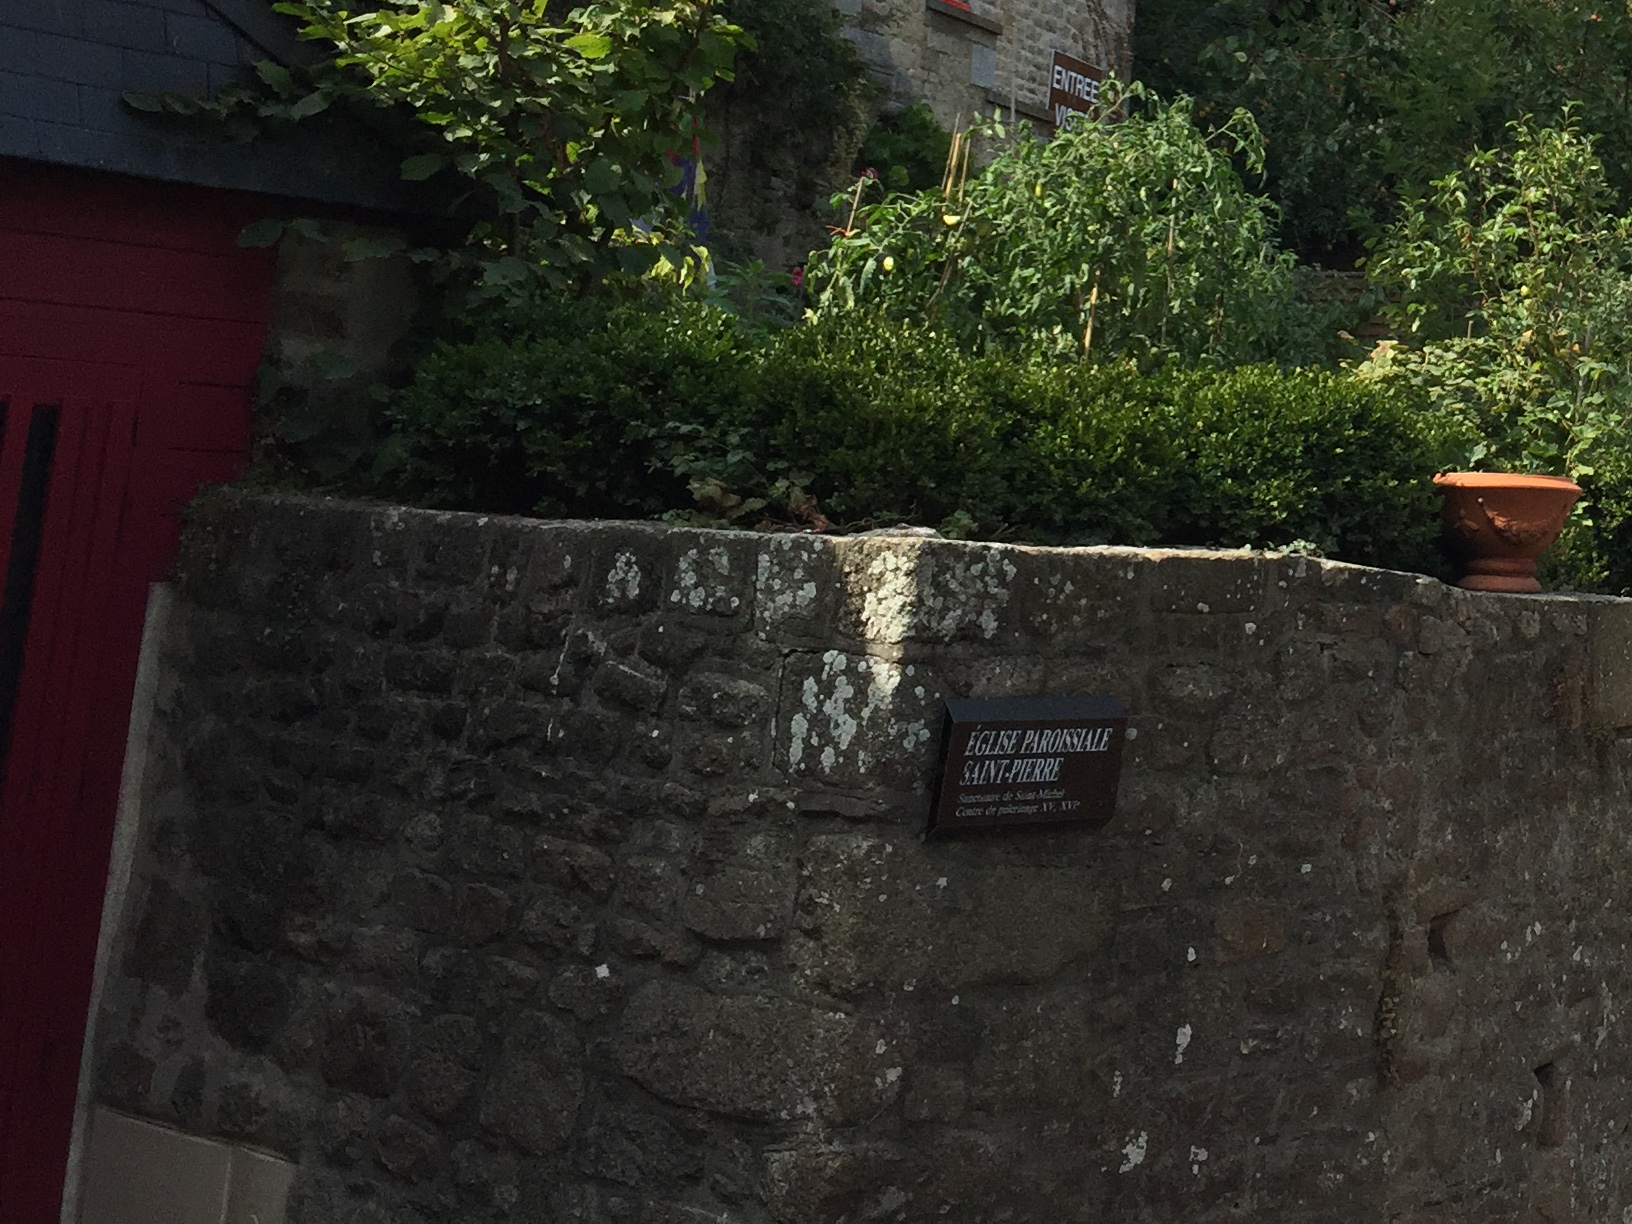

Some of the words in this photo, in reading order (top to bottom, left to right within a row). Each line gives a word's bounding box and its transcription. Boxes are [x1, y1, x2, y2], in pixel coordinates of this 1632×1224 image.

[963, 725, 1022, 756] ÉGLISE
[1019, 727, 1114, 755] PAROISSIALE
[959, 757, 1065, 786] SAINT-PIERRE
